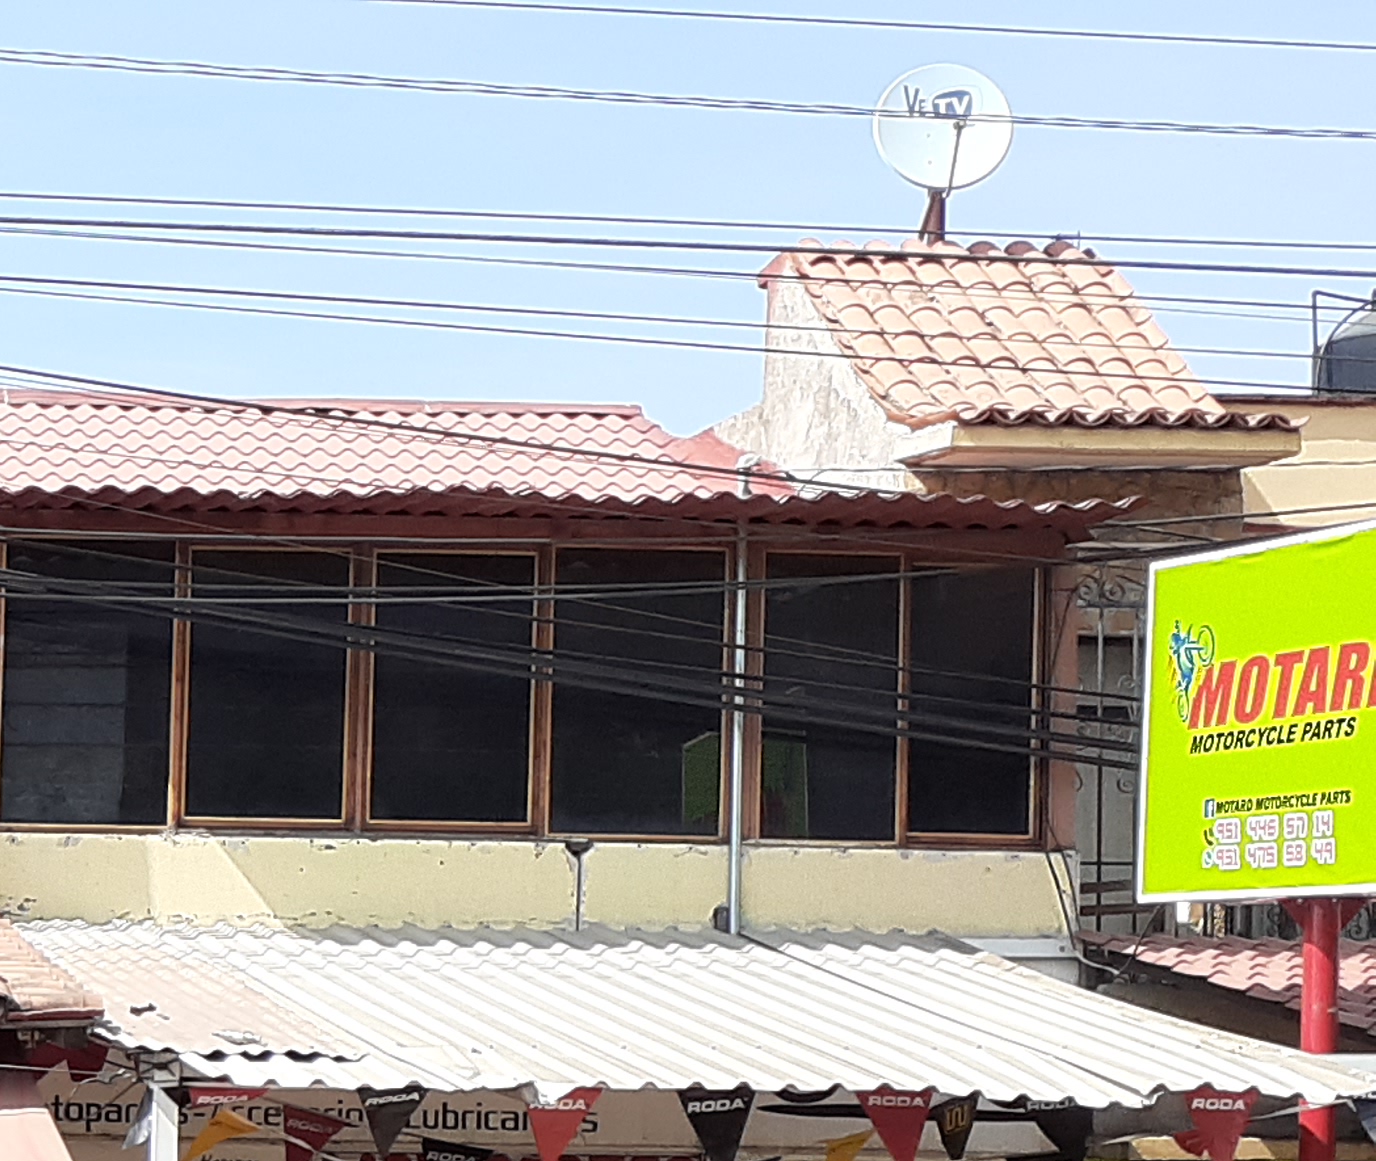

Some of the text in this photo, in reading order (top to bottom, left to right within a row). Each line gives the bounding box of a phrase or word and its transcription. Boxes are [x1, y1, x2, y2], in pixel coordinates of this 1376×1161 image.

[1190, 716, 1357, 755] MOTORCYCLE PARTS
[1216, 790, 1351, 814] MOTARD MOTORCYCLE PARTS
[1216, 821, 1239, 840] 951
[1285, 816, 1305, 836] 57
[1314, 814, 1331, 833] 14
[1216, 842, 1333, 866] 951 475 58 49
[686, 1098, 745, 1114] RODA
[867, 1095, 925, 1107] RODA
[1191, 1098, 1246, 1110] RODA
